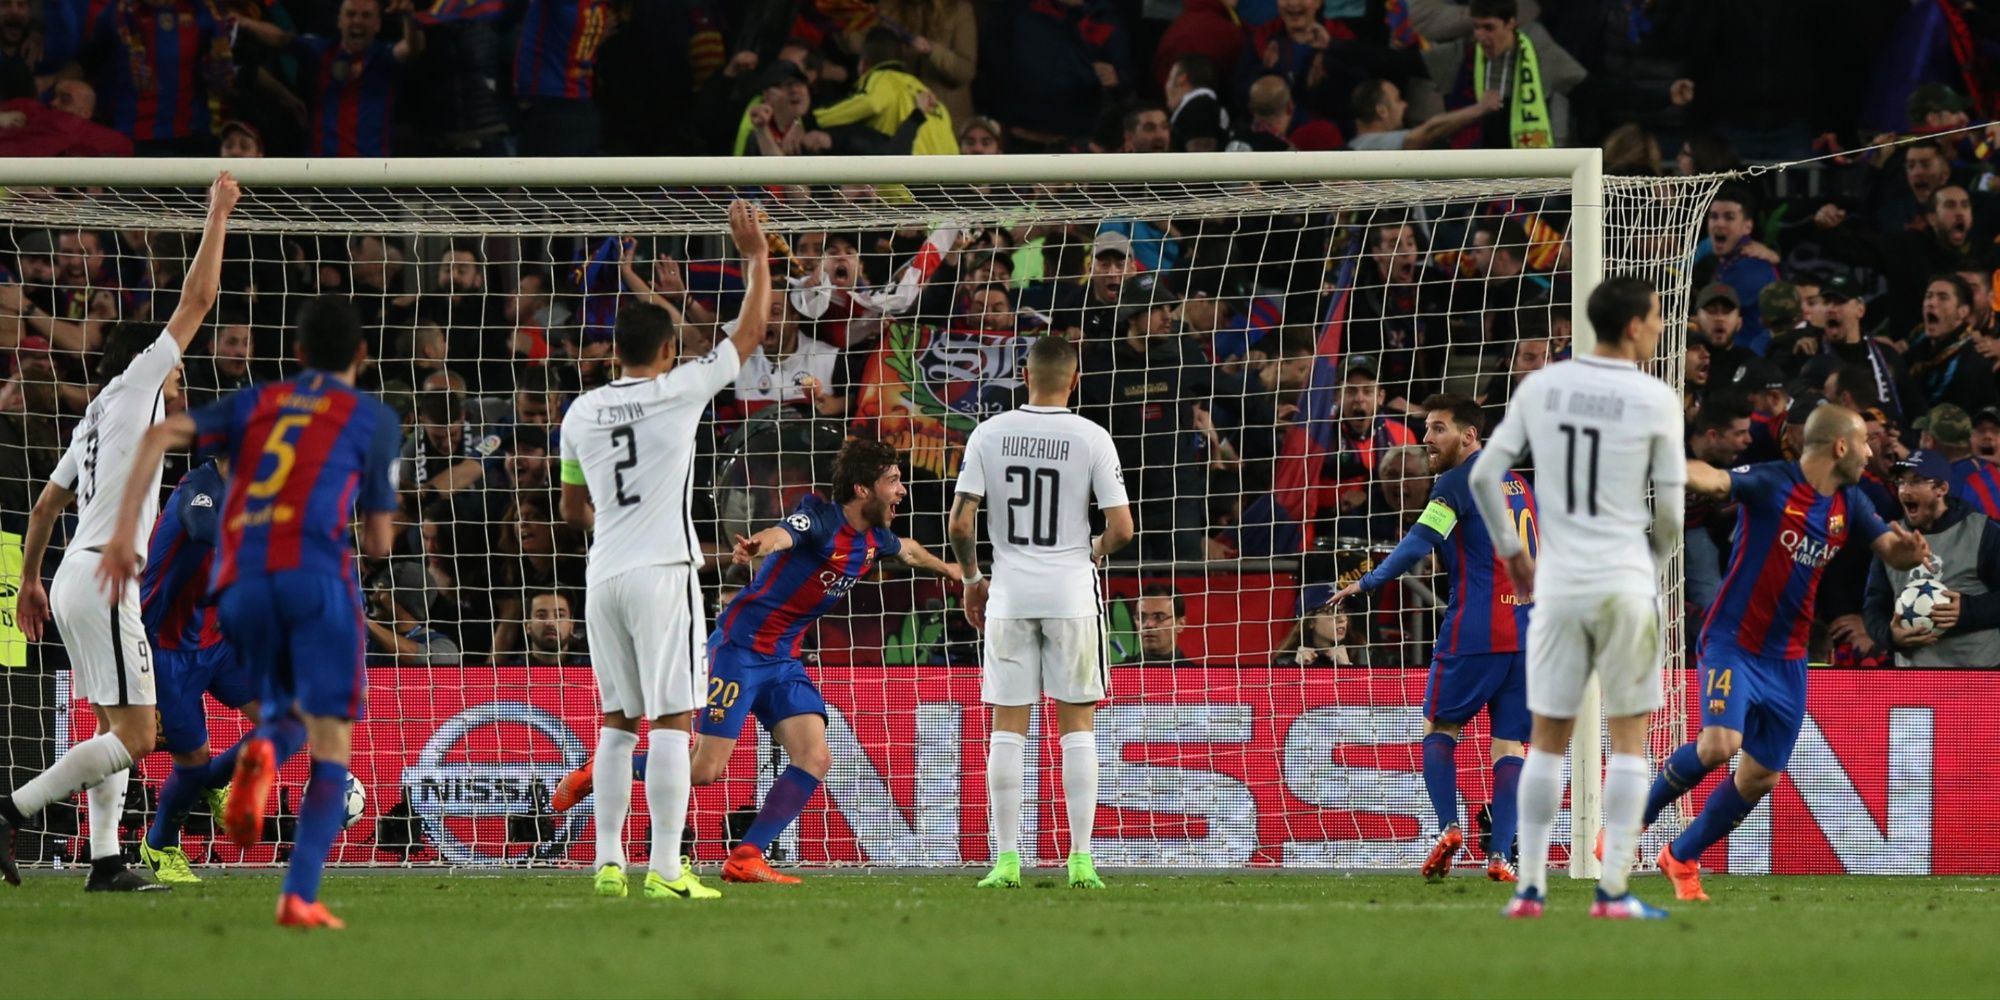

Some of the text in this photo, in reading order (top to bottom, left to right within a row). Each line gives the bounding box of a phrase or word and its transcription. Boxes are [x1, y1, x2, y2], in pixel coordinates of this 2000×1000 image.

[246, 414, 312, 498] 5
[611, 425, 641, 506] 2
[1002, 436, 1071, 462] KURZAWA
[1558, 424, 1600, 517] 11
[1005, 464, 1060, 547] 20
[138, 641, 149, 672] 9
[1706, 669, 1732, 697] 14
[707, 677, 739, 707] 20
